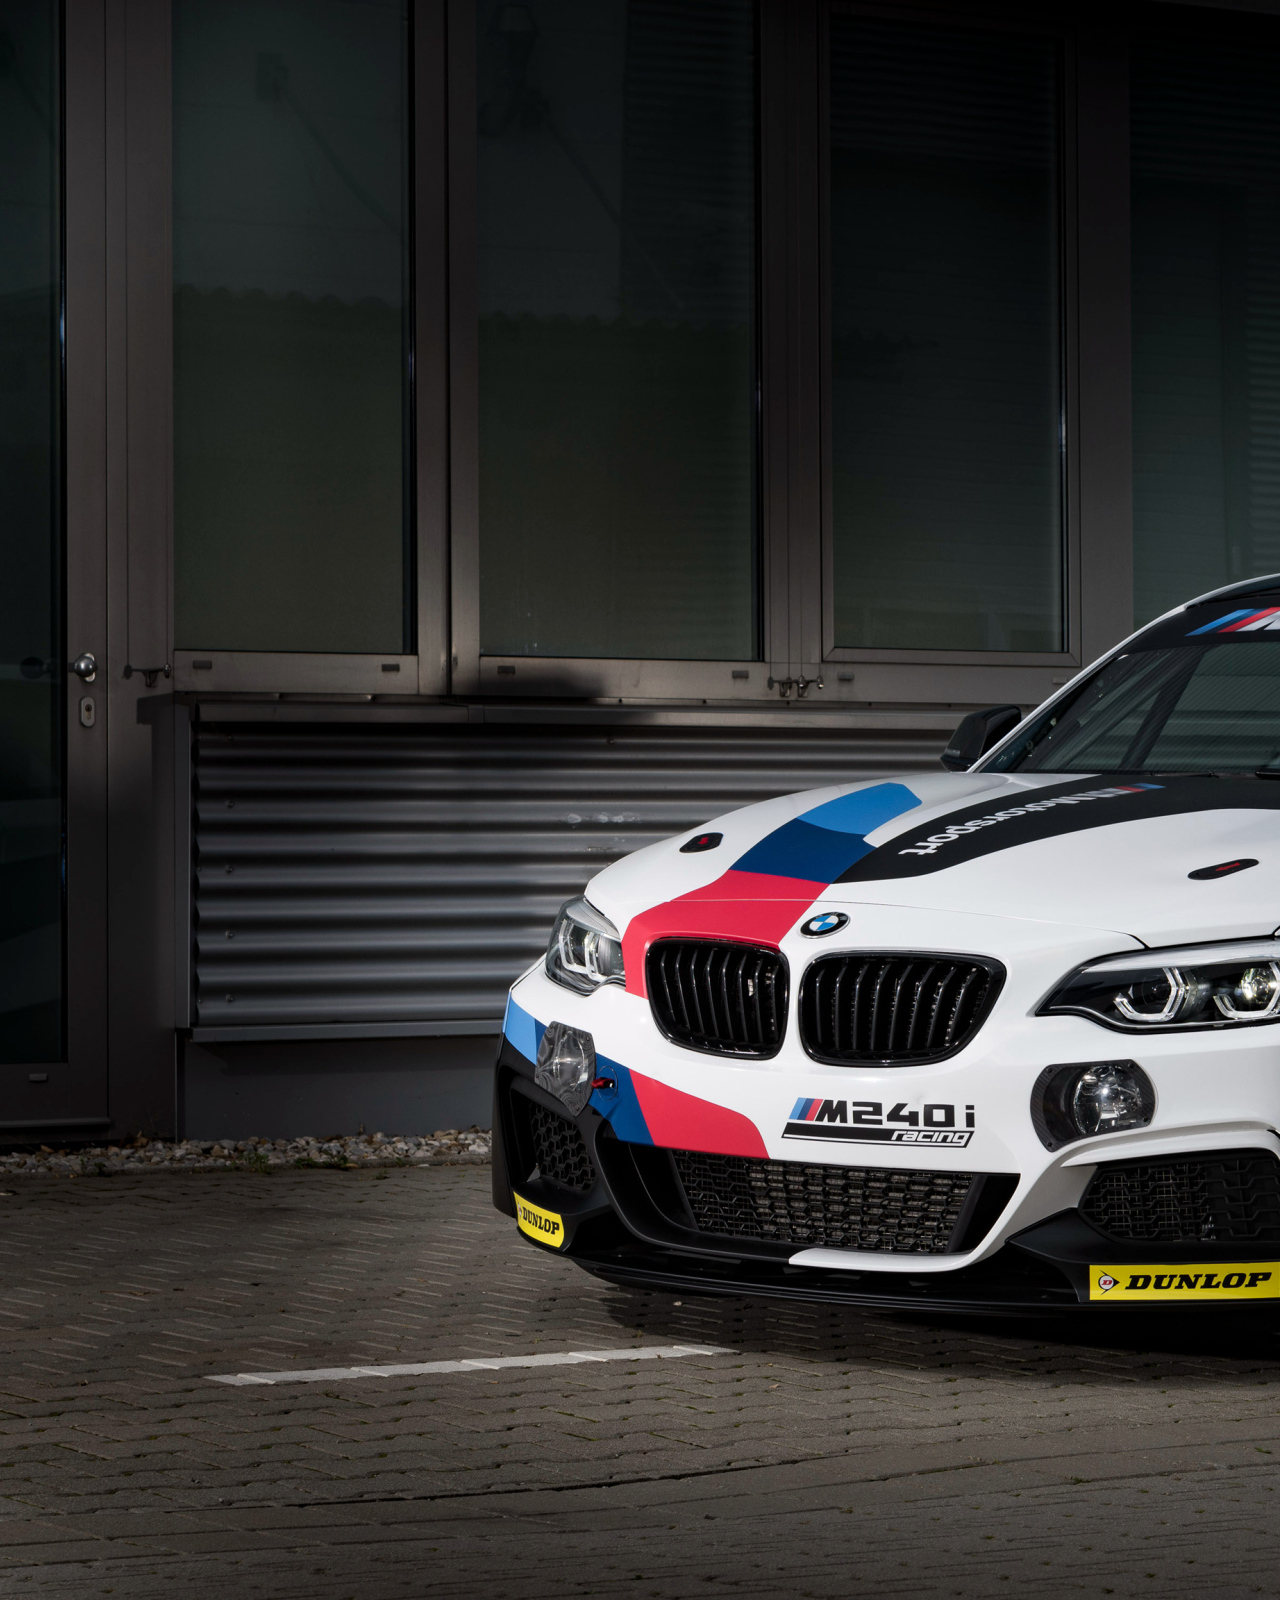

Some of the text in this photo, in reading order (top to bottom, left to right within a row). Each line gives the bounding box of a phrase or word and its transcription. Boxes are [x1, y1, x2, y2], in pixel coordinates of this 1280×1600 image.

[898, 793, 1098, 856] Motorsport
[814, 1098, 976, 1128] M240i
[891, 1130, 970, 1144] racing
[522, 1206, 560, 1235] DUNLOP
[1125, 1271, 1272, 1290] DUNLOP
